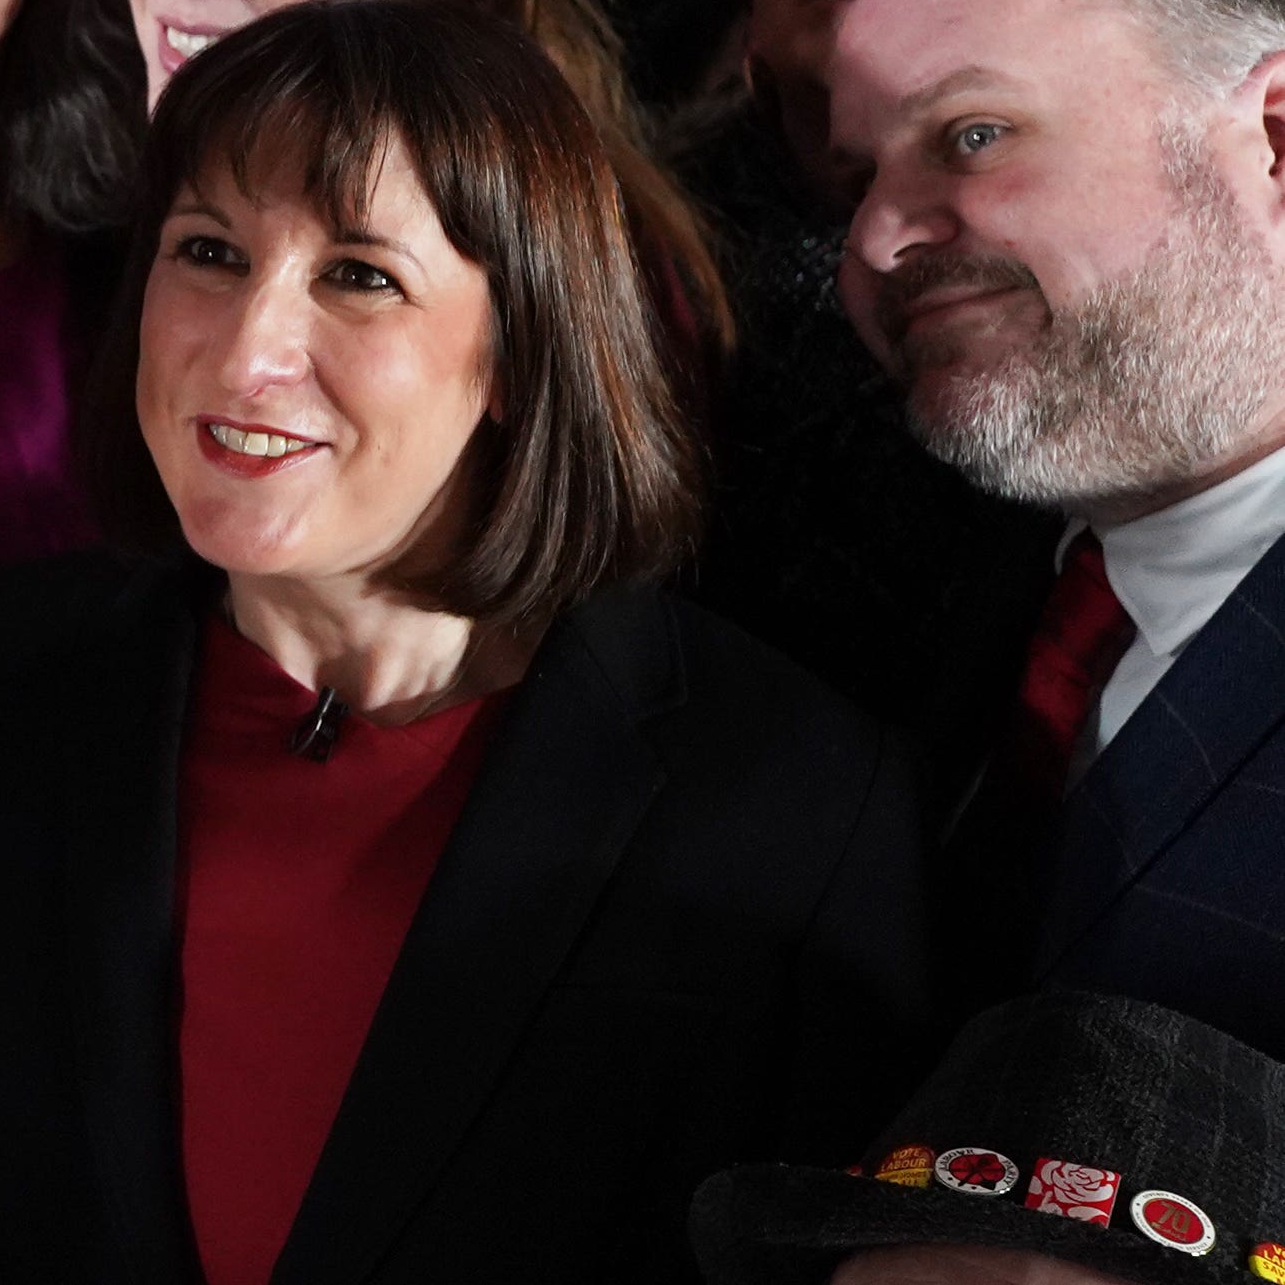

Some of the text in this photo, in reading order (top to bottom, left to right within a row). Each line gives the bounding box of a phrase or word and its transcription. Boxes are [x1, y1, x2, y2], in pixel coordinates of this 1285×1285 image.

[893, 1148, 920, 1159] VOTE
[881, 1158, 927, 1172] LABOUR
[1158, 1201, 1193, 1234] 70
